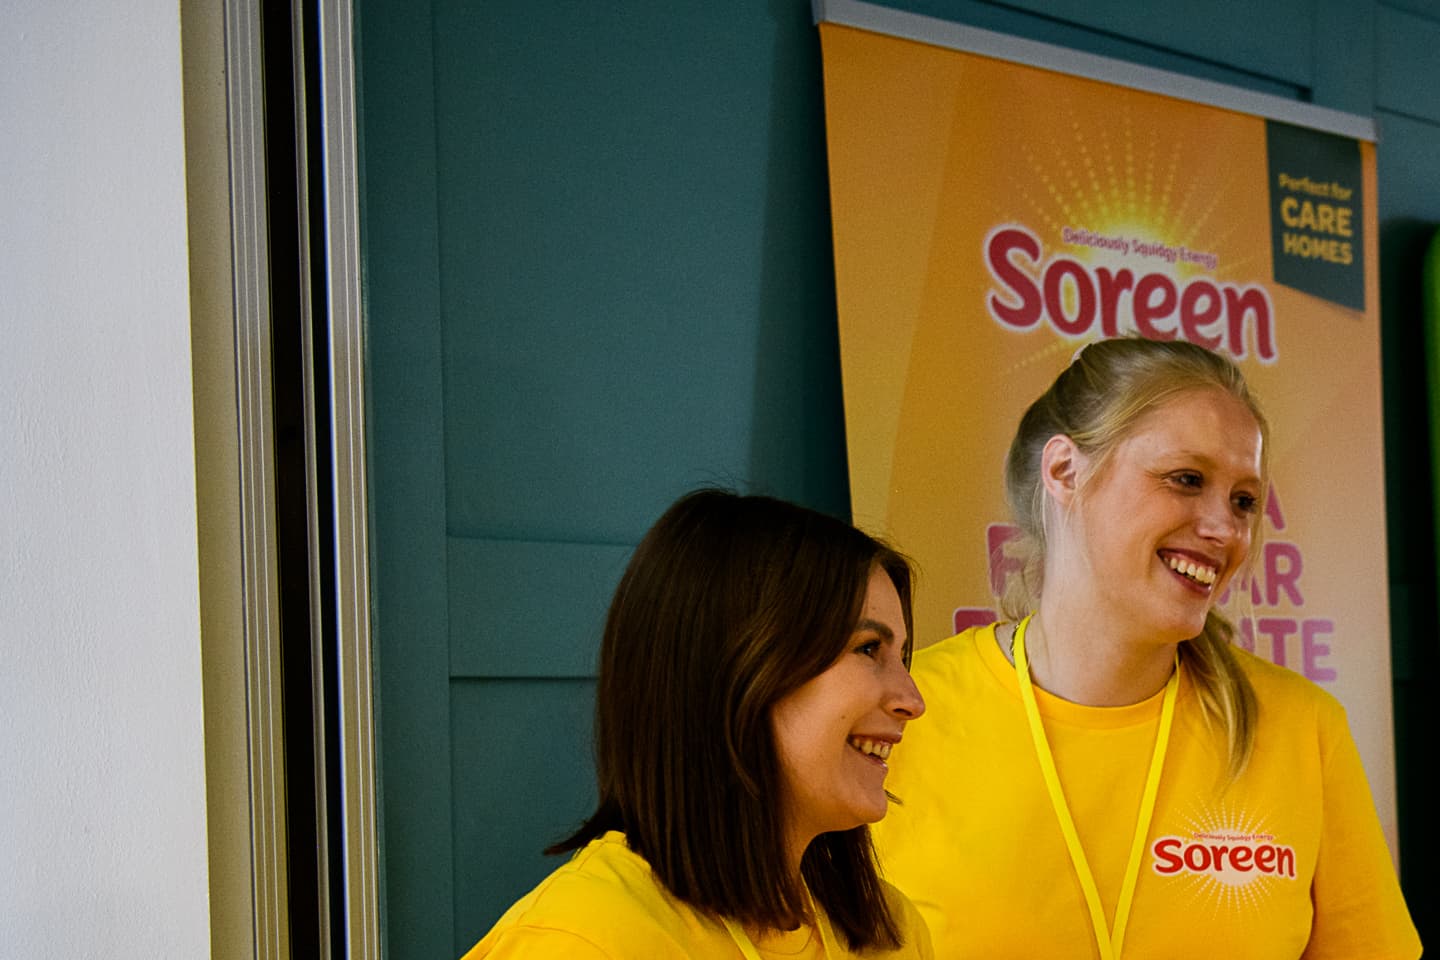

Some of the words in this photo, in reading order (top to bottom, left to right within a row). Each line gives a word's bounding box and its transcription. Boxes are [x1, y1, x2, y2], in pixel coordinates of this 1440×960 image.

[1281, 197, 1352, 237] CARE
[1282, 233, 1353, 265] HOMES
[987, 228, 1275, 361] Soreen
[1154, 839, 1295, 877] Soreen
